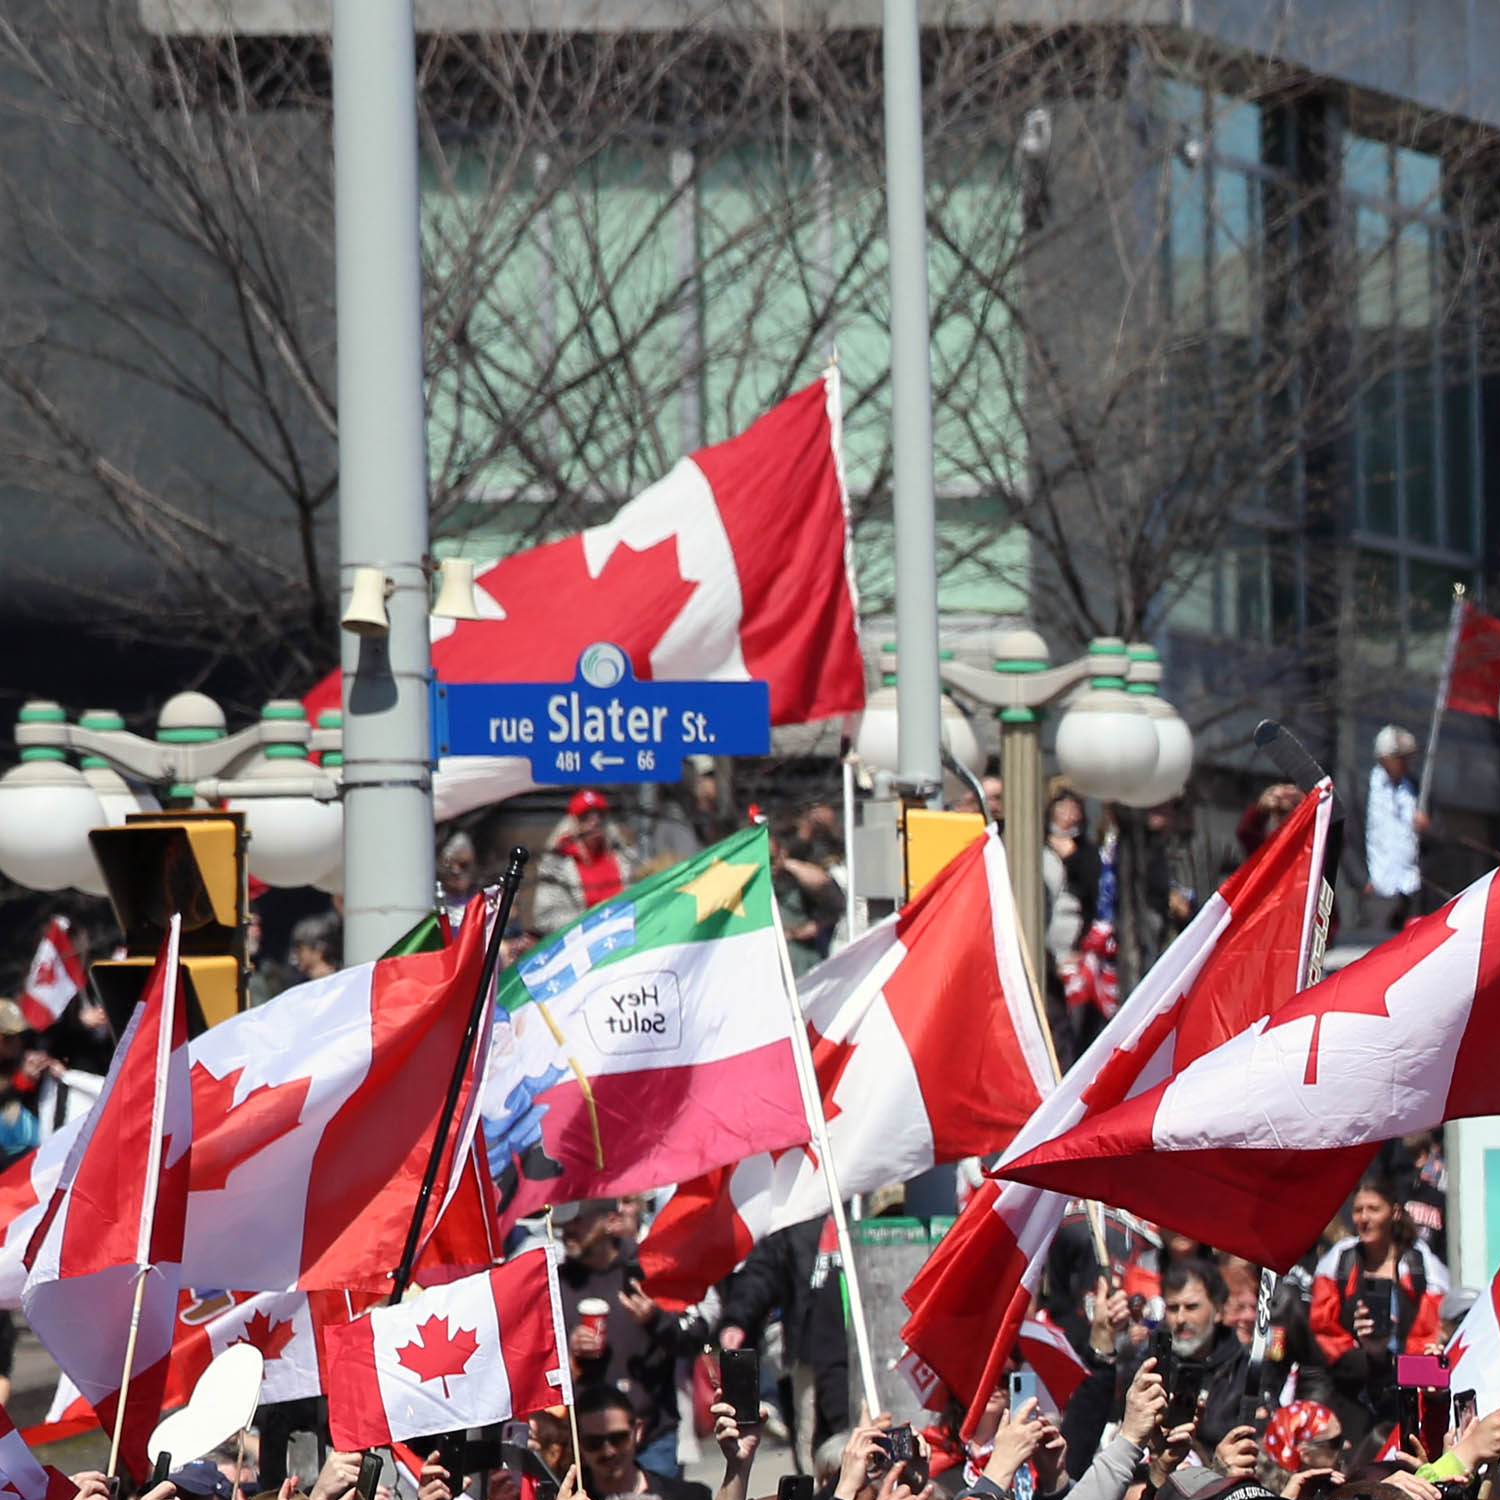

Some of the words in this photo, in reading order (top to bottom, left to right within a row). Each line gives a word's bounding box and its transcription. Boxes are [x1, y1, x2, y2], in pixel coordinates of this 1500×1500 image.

[489, 717, 534, 743] rue
[547, 691, 669, 744] Slater
[681, 710, 717, 743] St.
[555, 750, 581, 772] 481
[637, 750, 655, 771] 66
